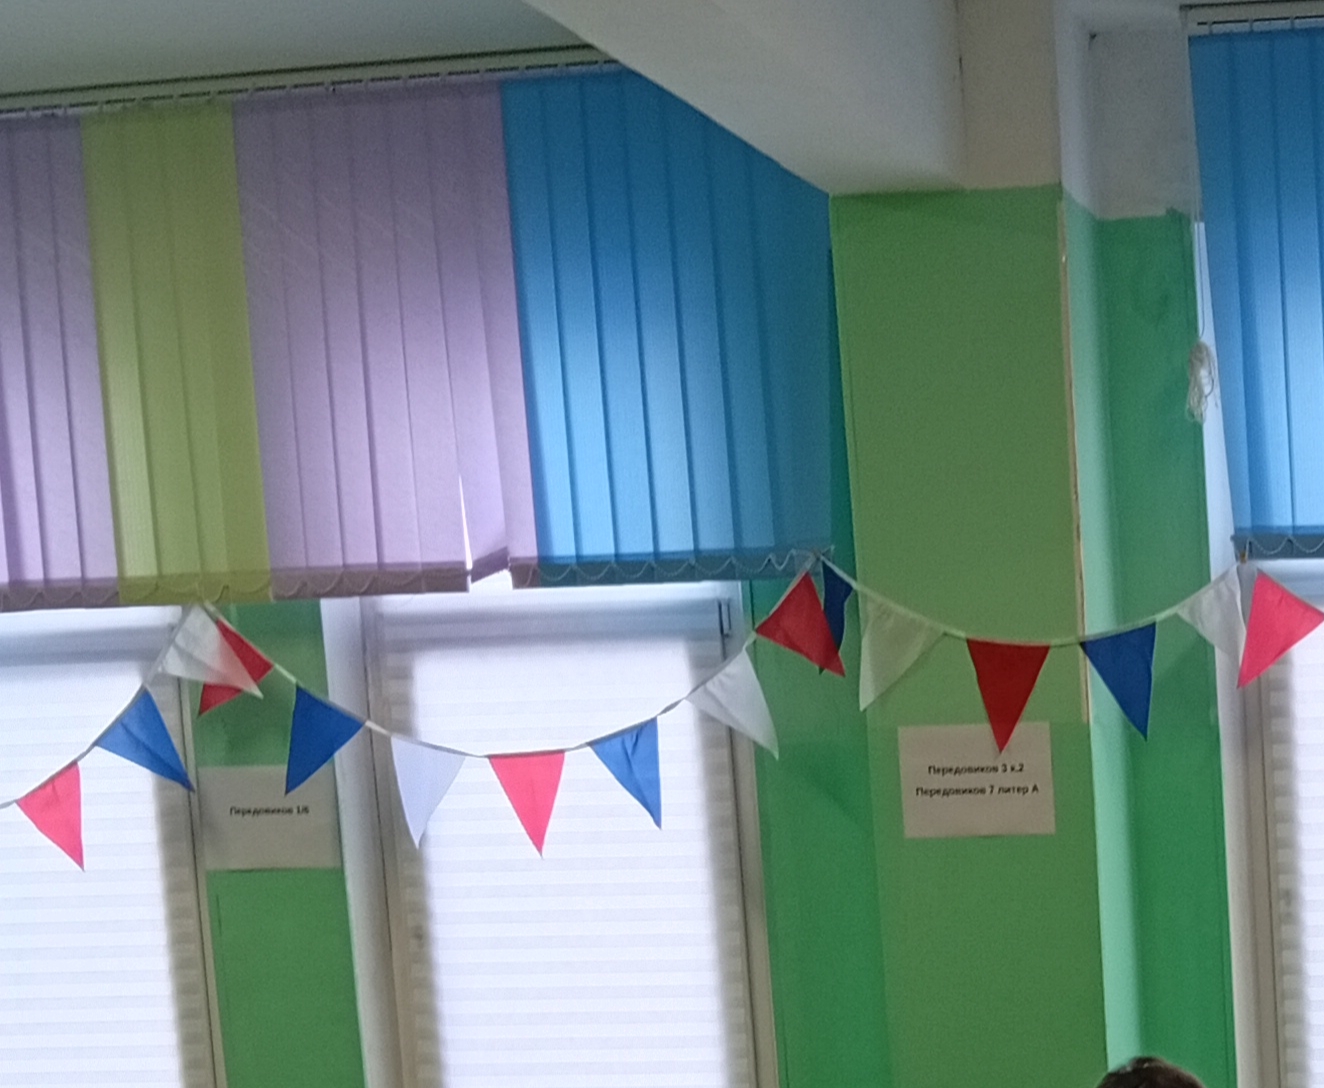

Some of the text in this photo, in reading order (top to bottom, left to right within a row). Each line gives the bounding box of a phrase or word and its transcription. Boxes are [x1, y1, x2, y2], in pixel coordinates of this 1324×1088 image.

[928, 765, 998, 777] Передовиков
[915, 787, 986, 799] Передовиков
[989, 785, 995, 794] 7
[998, 784, 1029, 796] литер
